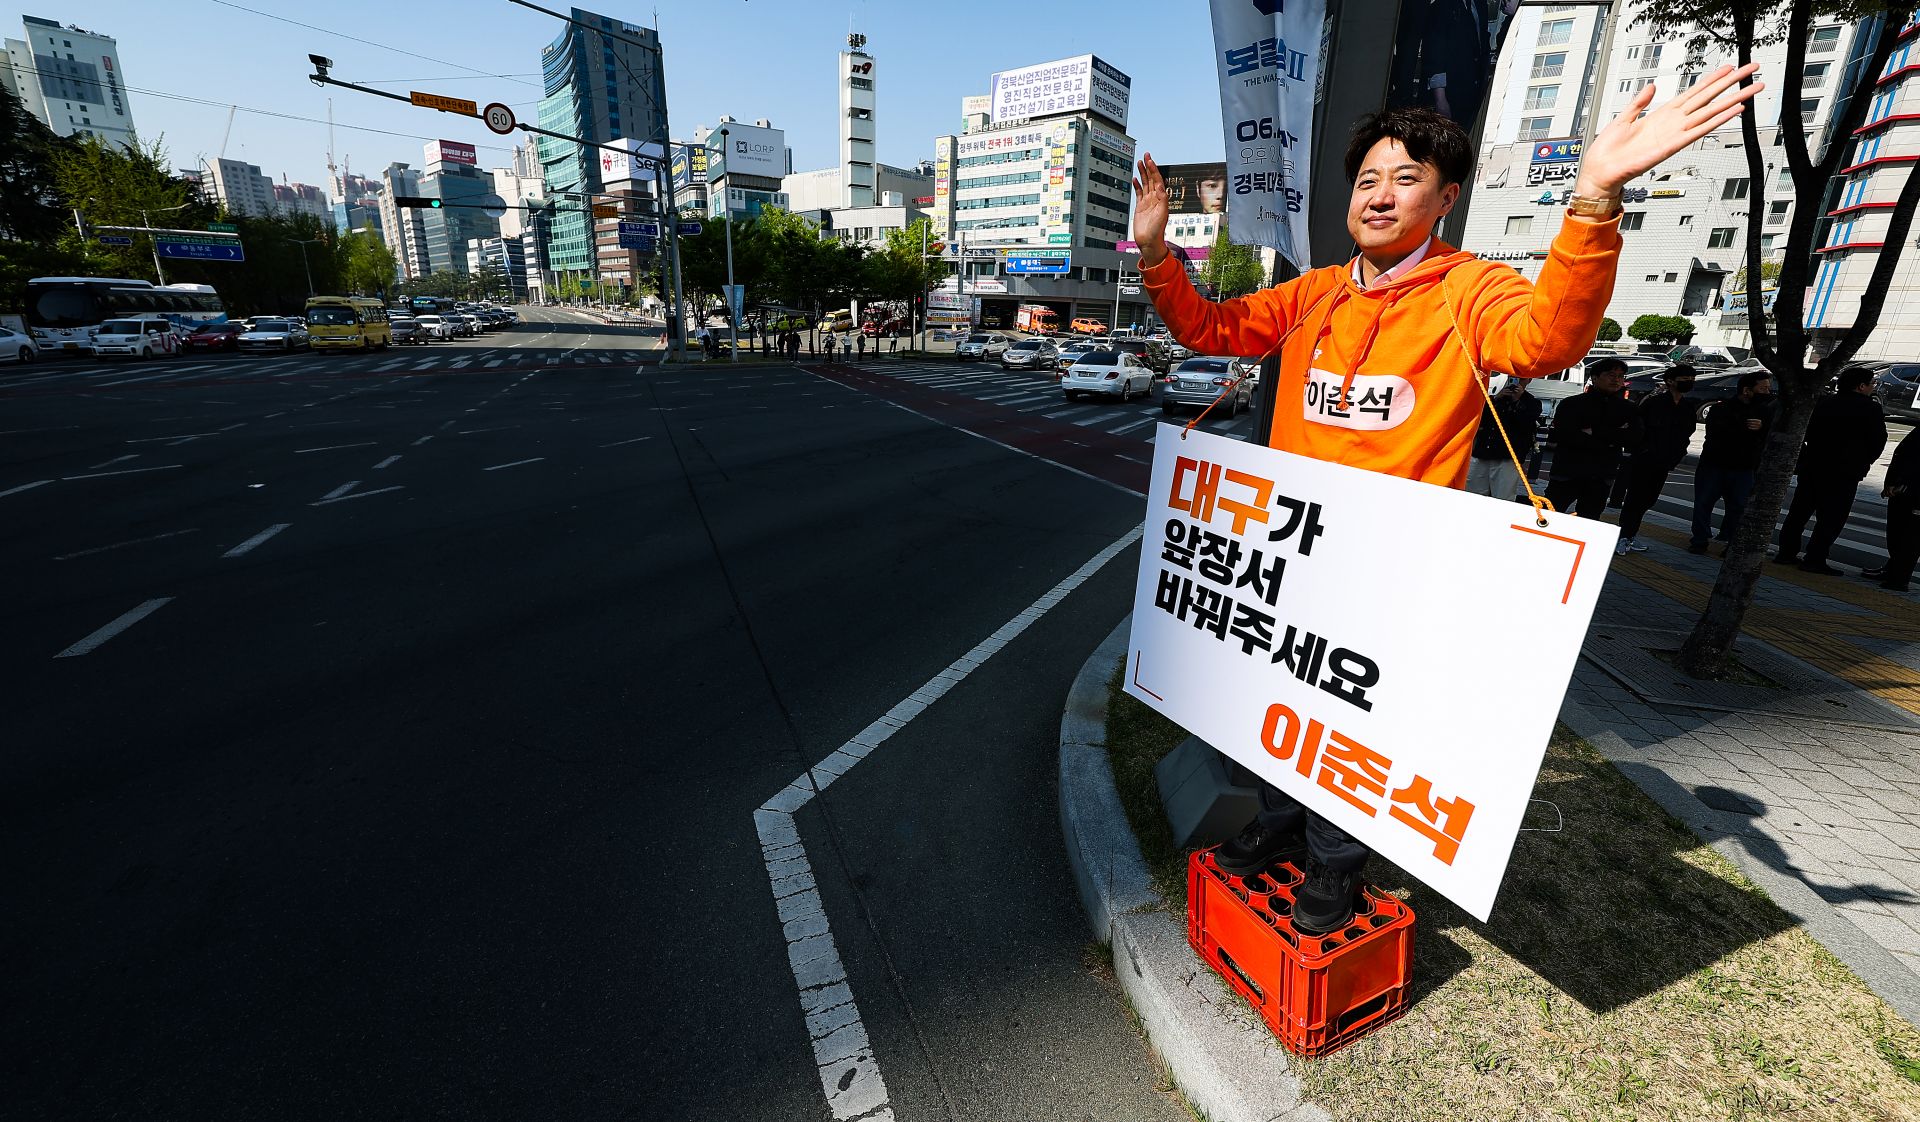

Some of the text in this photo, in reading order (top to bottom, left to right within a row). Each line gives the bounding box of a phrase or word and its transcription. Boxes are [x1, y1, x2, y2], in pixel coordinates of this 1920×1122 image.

[1001, 61, 1088, 90] 경북산업직업전문학교
[1243, 76, 1262, 88] THE
[1003, 78, 1083, 104] 영진직업전문학교
[492, 112, 508, 126] 60
[999, 92, 1086, 119] 영진건설기술교육원
[691, 155, 707, 164] 가정용
[691, 163, 708, 171] 보일러
[1308, 381, 1394, 421] 이준석
[1167, 455, 1325, 557] 대구가
[1160, 518, 1287, 607] 앞장서
[1154, 568, 1380, 712] 바꿔주세요
[1260, 702, 1476, 867] 이준석
